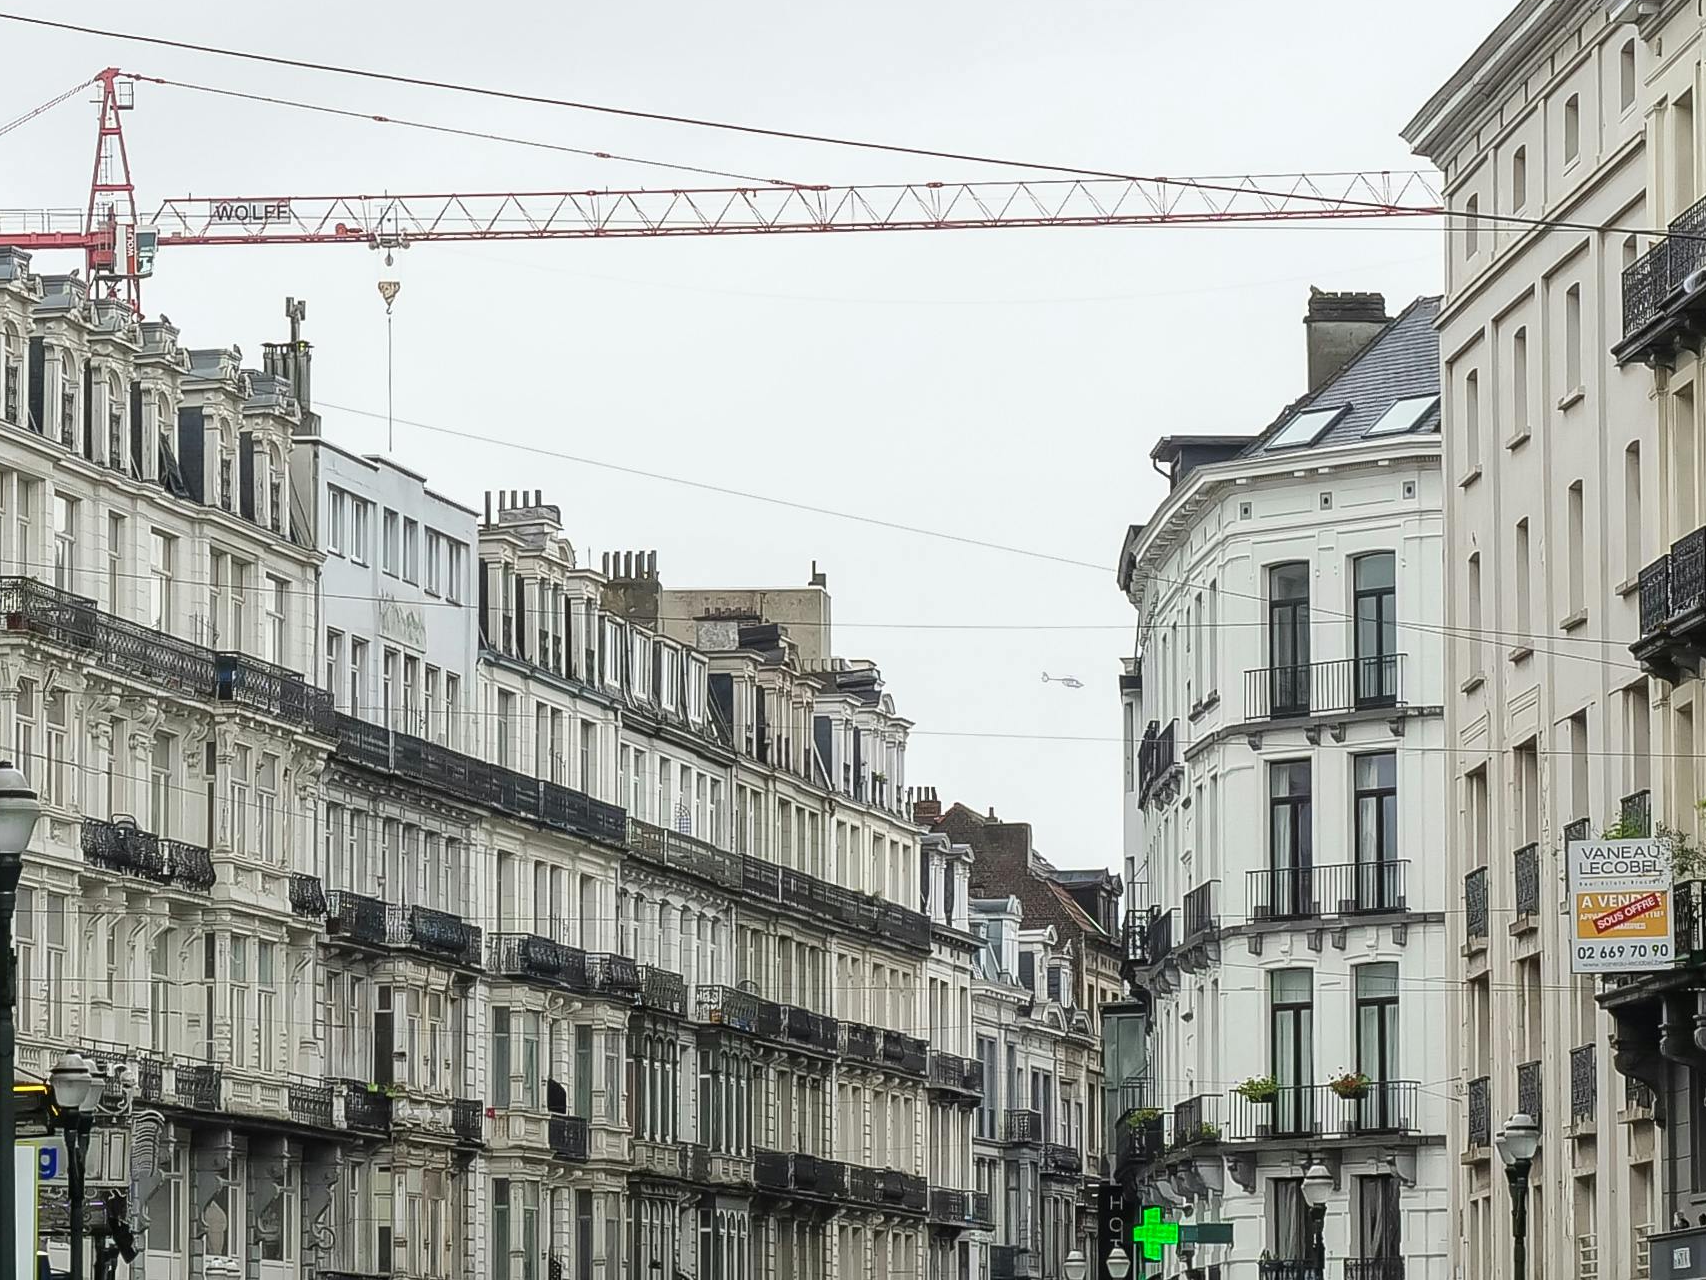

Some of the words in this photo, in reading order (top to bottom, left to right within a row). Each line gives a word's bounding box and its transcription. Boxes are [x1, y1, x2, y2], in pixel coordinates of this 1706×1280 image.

[215, 205, 288, 221] WOLFF
[1581, 846, 1661, 860] VANEAU
[1579, 860, 1664, 875] LECOBEL
[1581, 895, 1593, 909] A
[1597, 911, 1624, 929] SOUS
[1624, 896, 1656, 917] OFFRE
[1577, 946, 1595, 959] 02
[1599, 945, 1625, 958] 669
[1630, 944, 1648, 957] 70
[1652, 943, 1669, 957] 90
